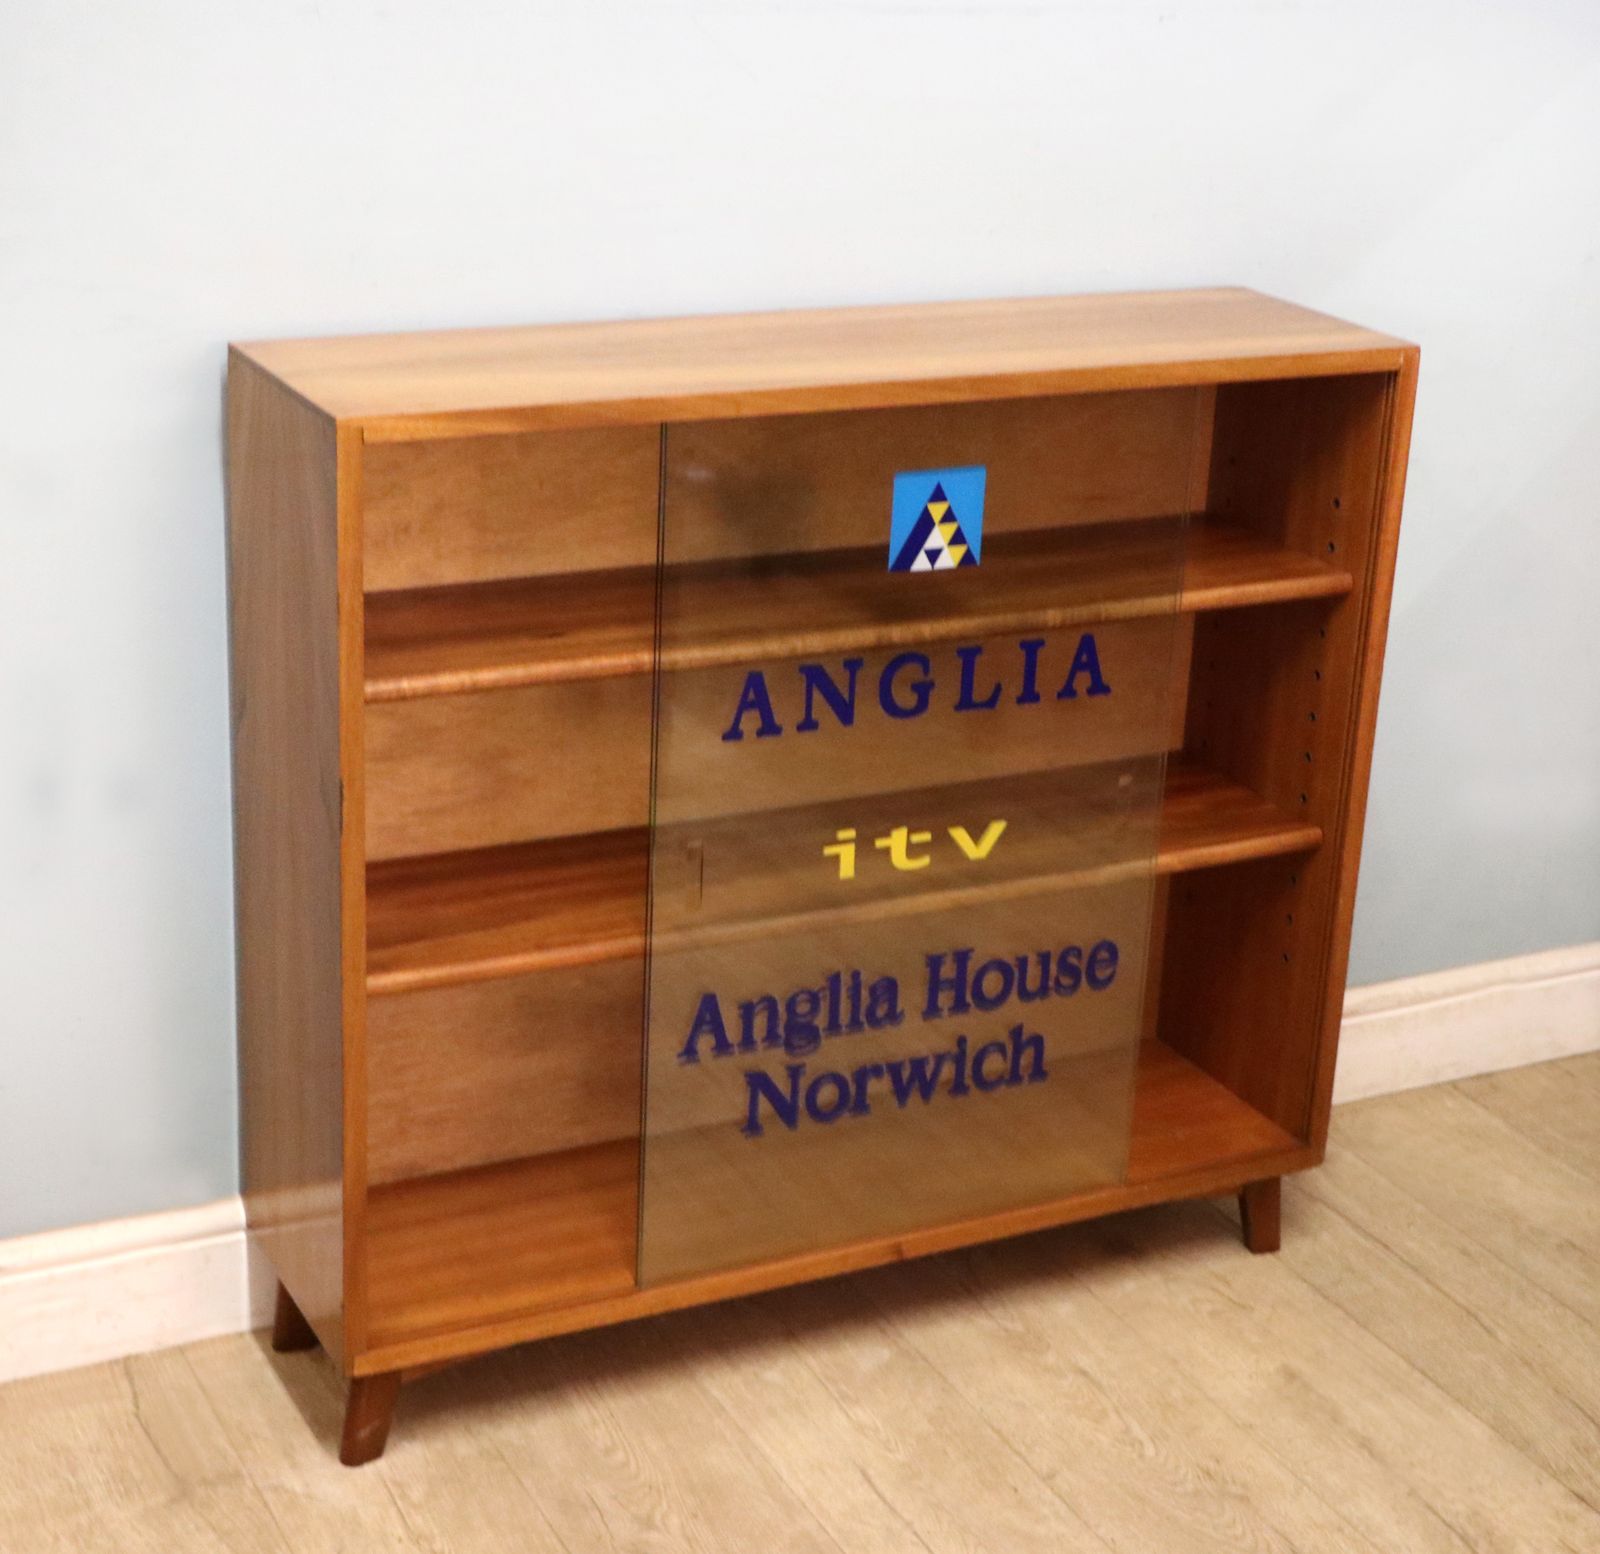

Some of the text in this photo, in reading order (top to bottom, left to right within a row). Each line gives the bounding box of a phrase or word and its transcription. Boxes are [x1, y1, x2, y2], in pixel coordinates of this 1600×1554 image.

[722, 633, 1110, 742] ANGLIA
[822, 819, 1008, 881] itv
[678, 939, 1119, 1064] Anglia House
[742, 1025, 1047, 1137] Norwich
